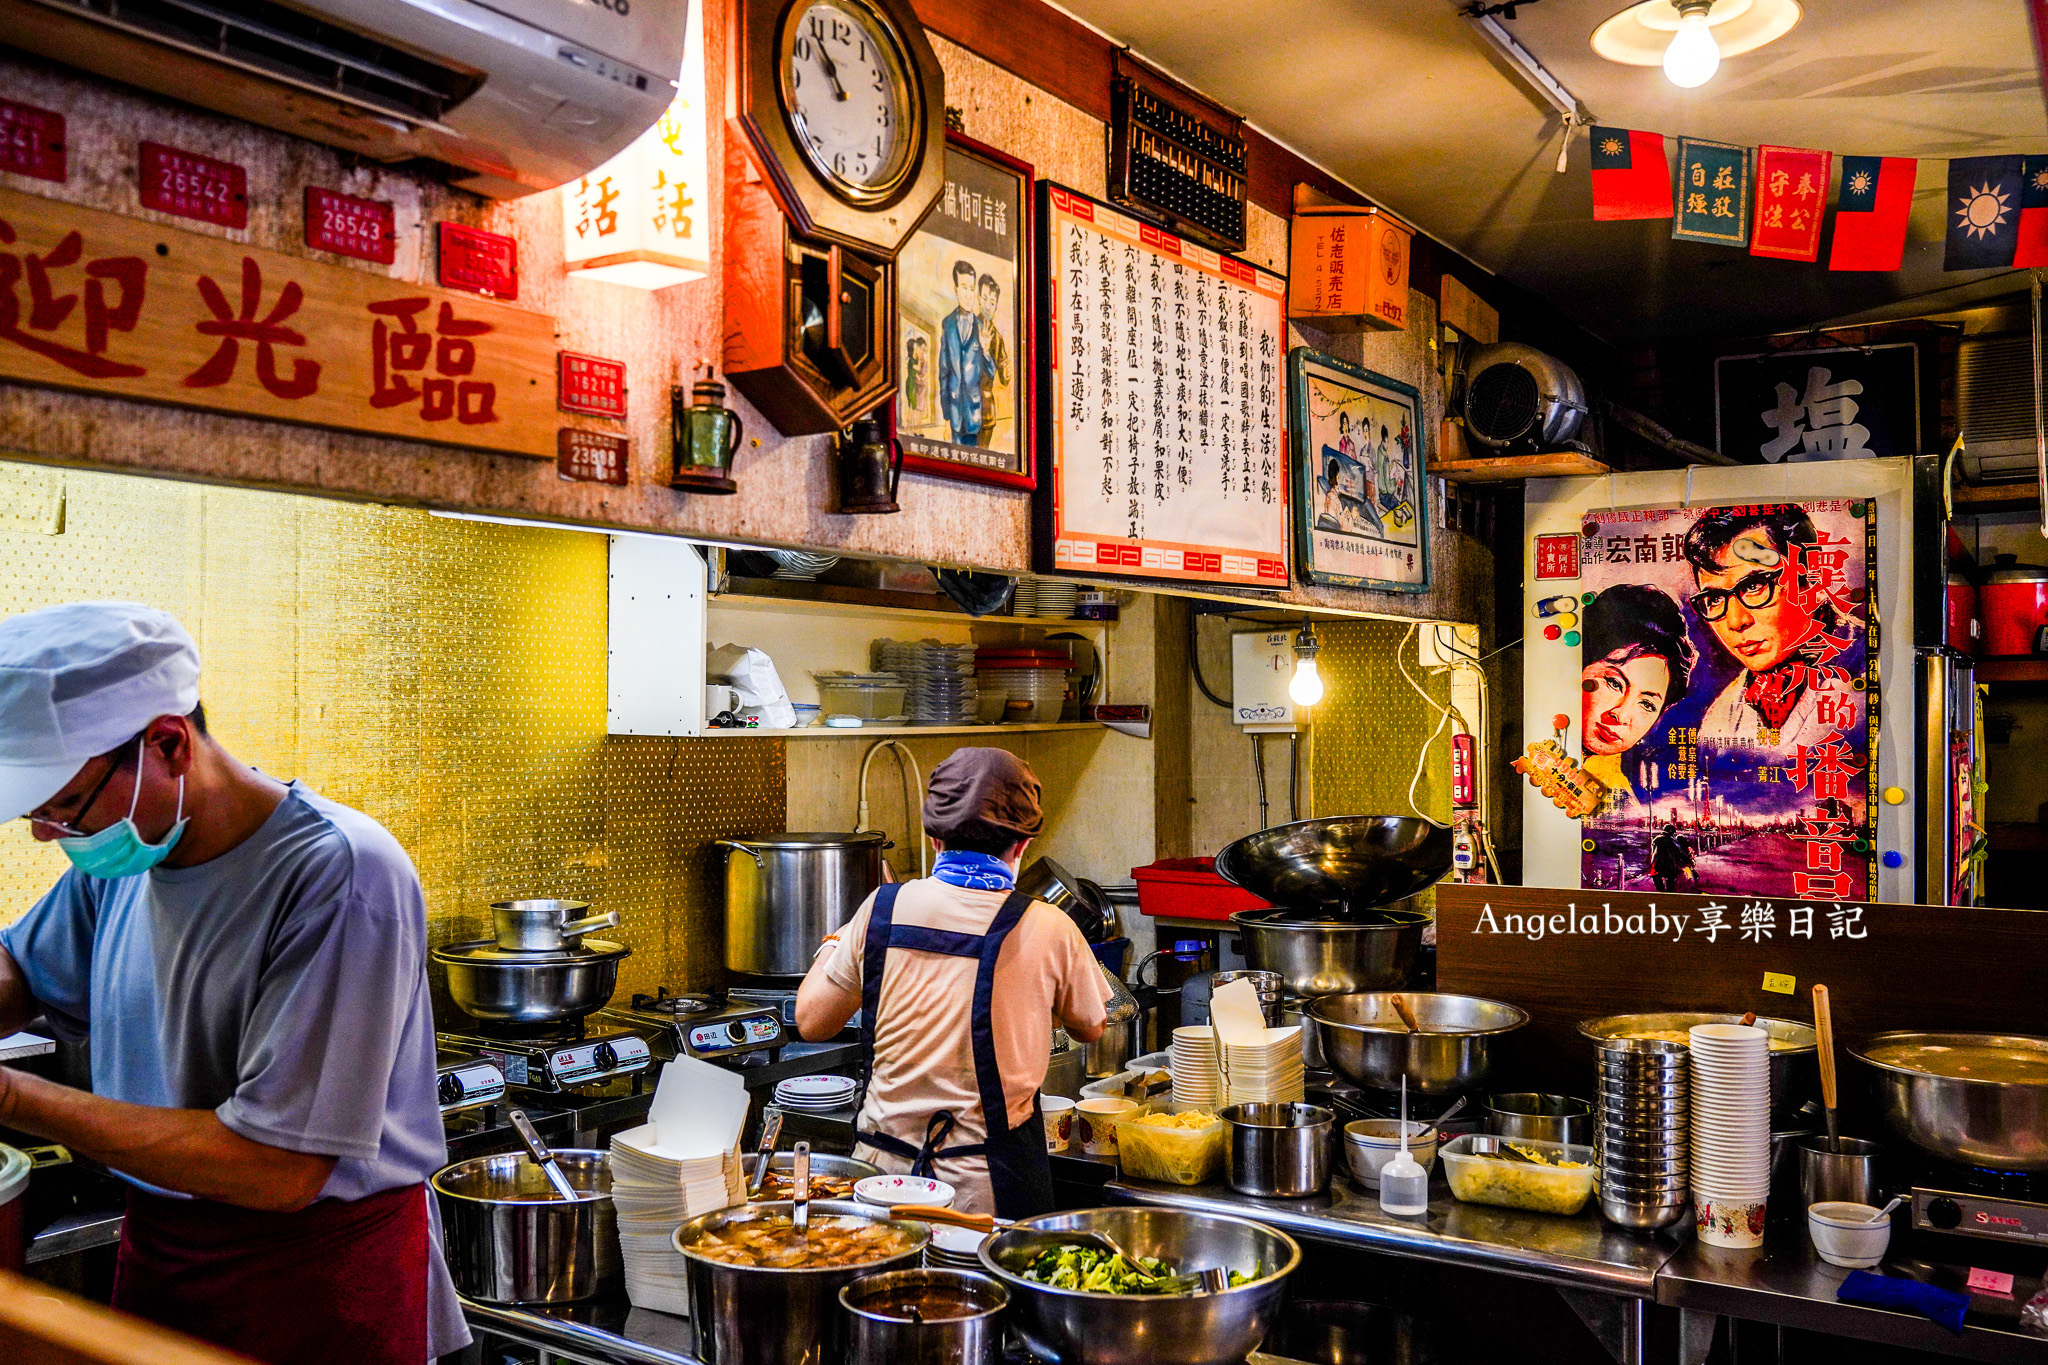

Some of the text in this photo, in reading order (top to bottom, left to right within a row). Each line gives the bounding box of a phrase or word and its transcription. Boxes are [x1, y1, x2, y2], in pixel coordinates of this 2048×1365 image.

[831, 18, 851, 46] 12
[160, 167, 230, 204] 26542
[1711, 166, 1736, 218] 莊敬
[1763, 169, 1790, 229] 守法
[1789, 171, 1817, 231] 奉公
[322, 210, 381, 241] 26543
[1326, 226, 1346, 309] 佐志販売店
[1258, 328, 1273, 505] 我們的生活公約
[1606, 532, 1687, 564] 郭南宏
